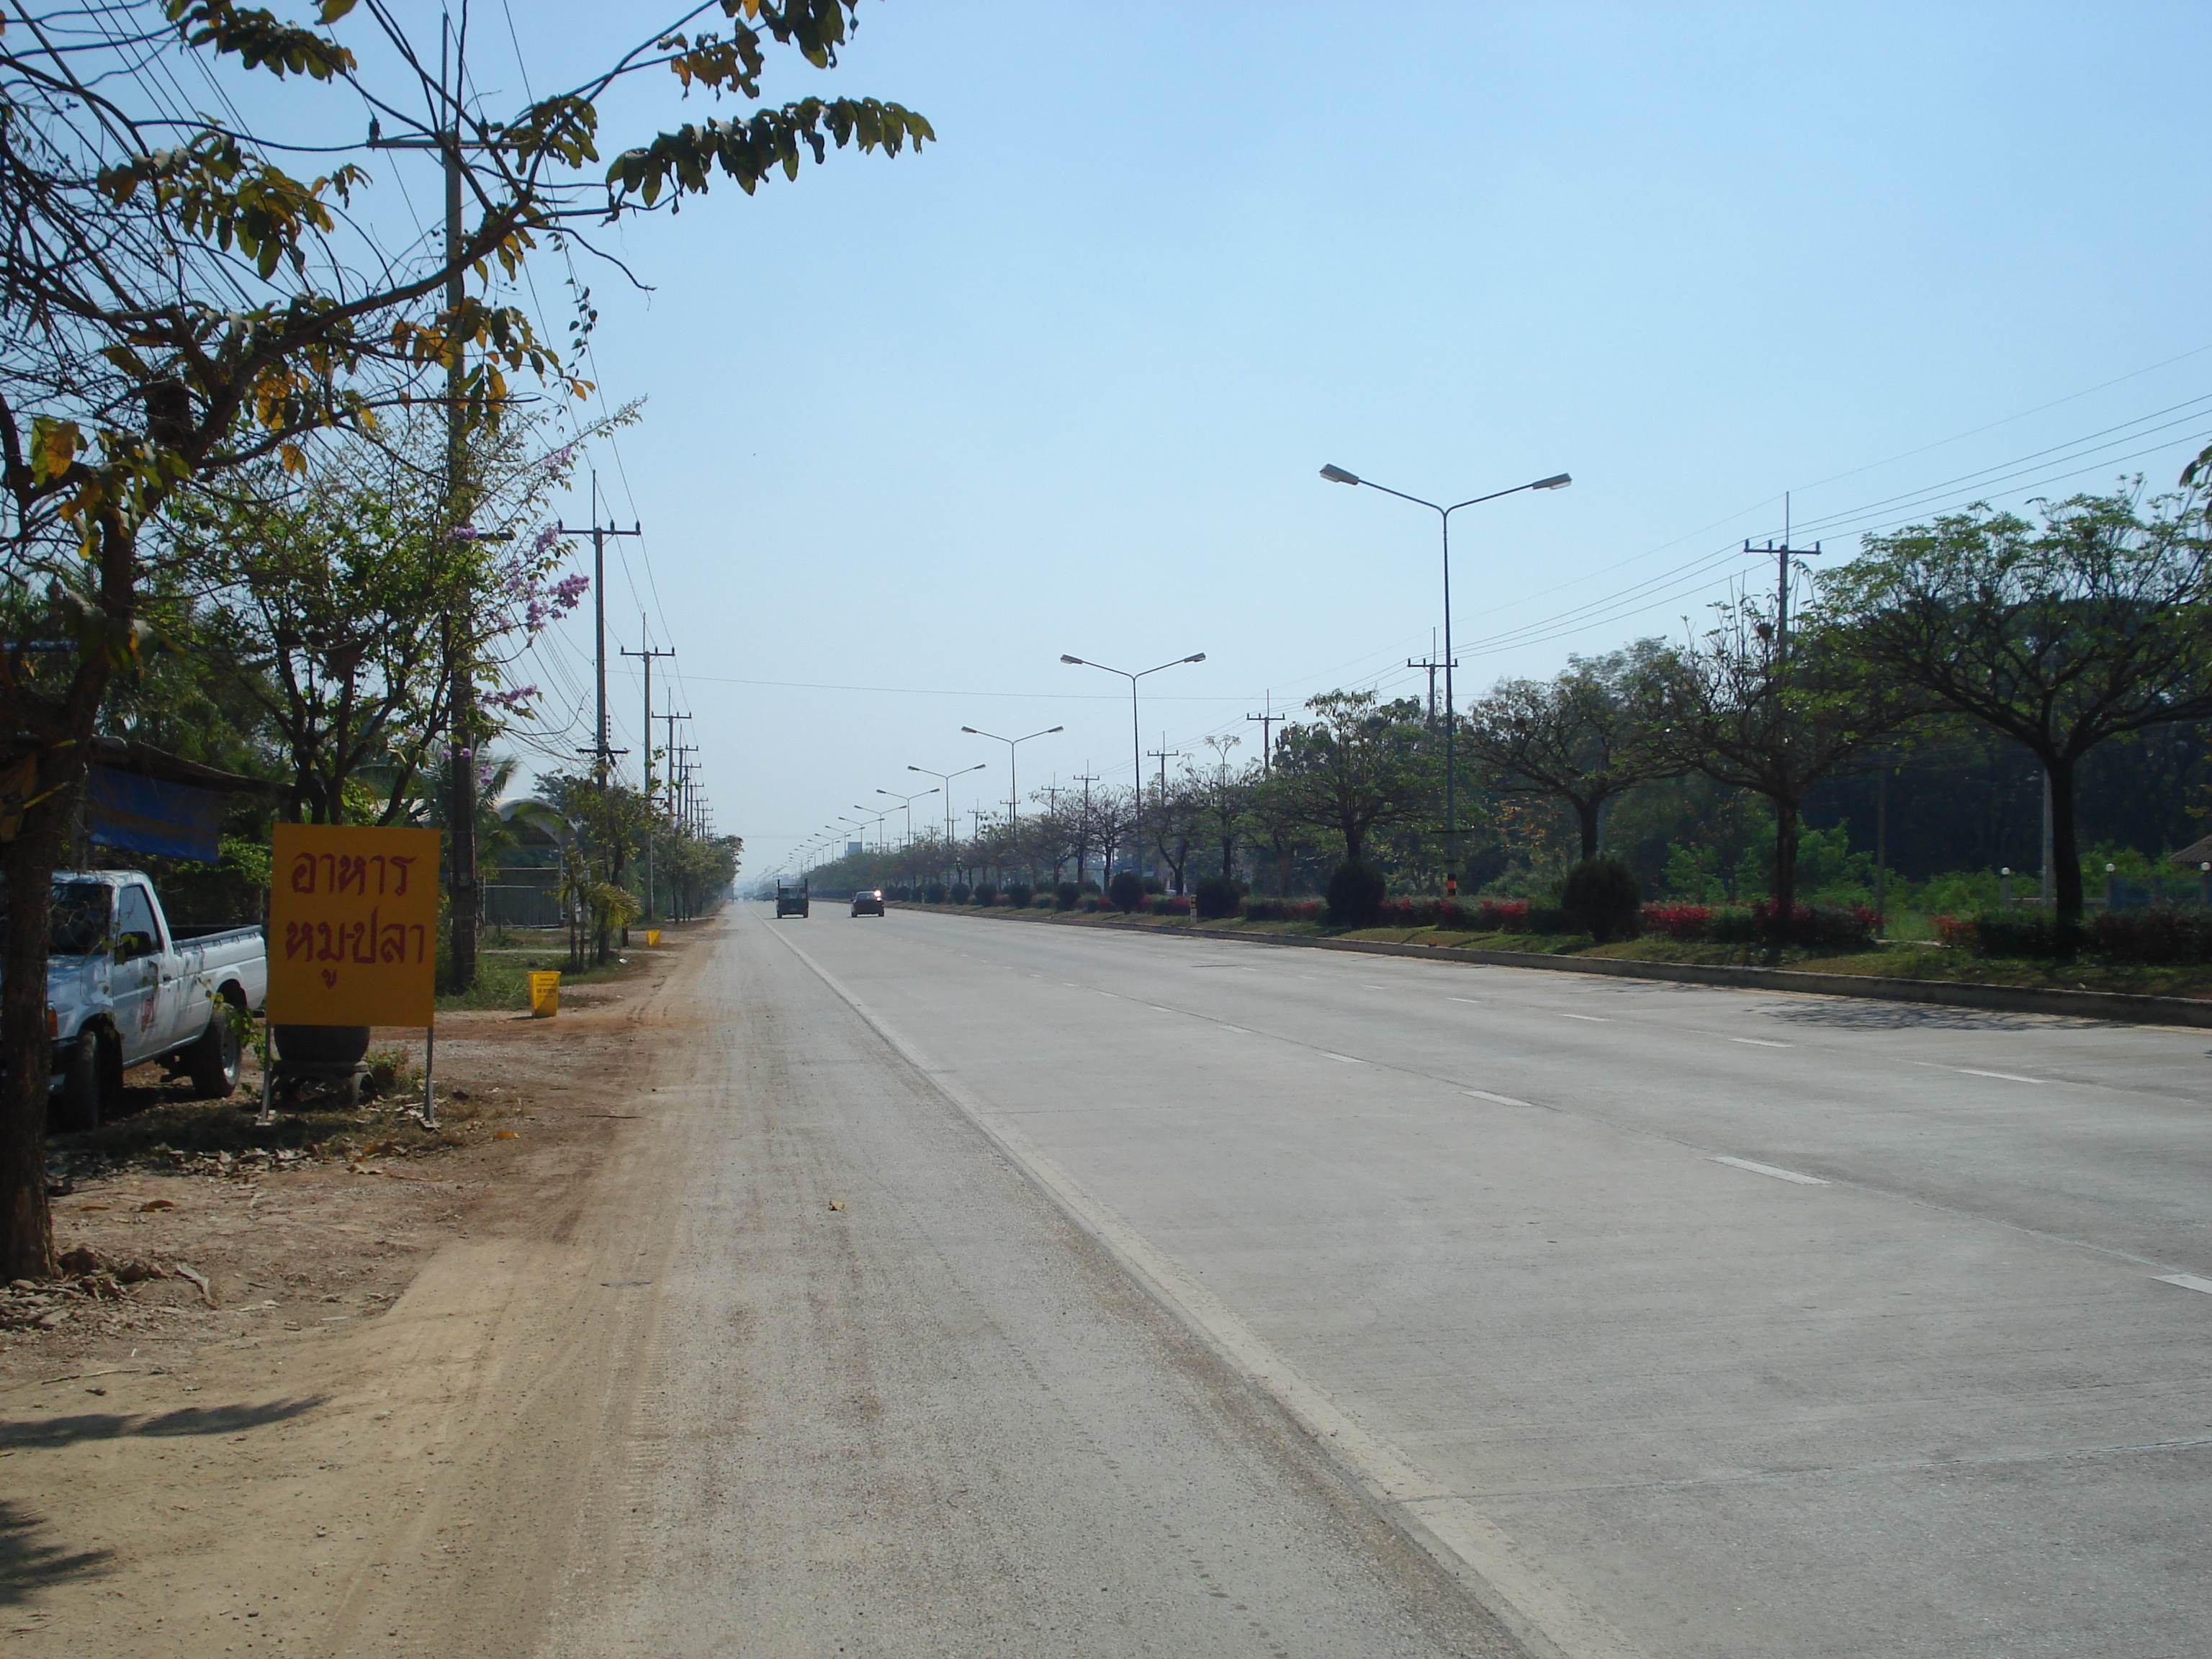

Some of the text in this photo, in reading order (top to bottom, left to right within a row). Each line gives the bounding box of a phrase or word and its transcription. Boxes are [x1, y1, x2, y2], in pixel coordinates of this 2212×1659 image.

[292, 852, 417, 896] อาหาร
[286, 907, 425, 989] หมู-ปลา
